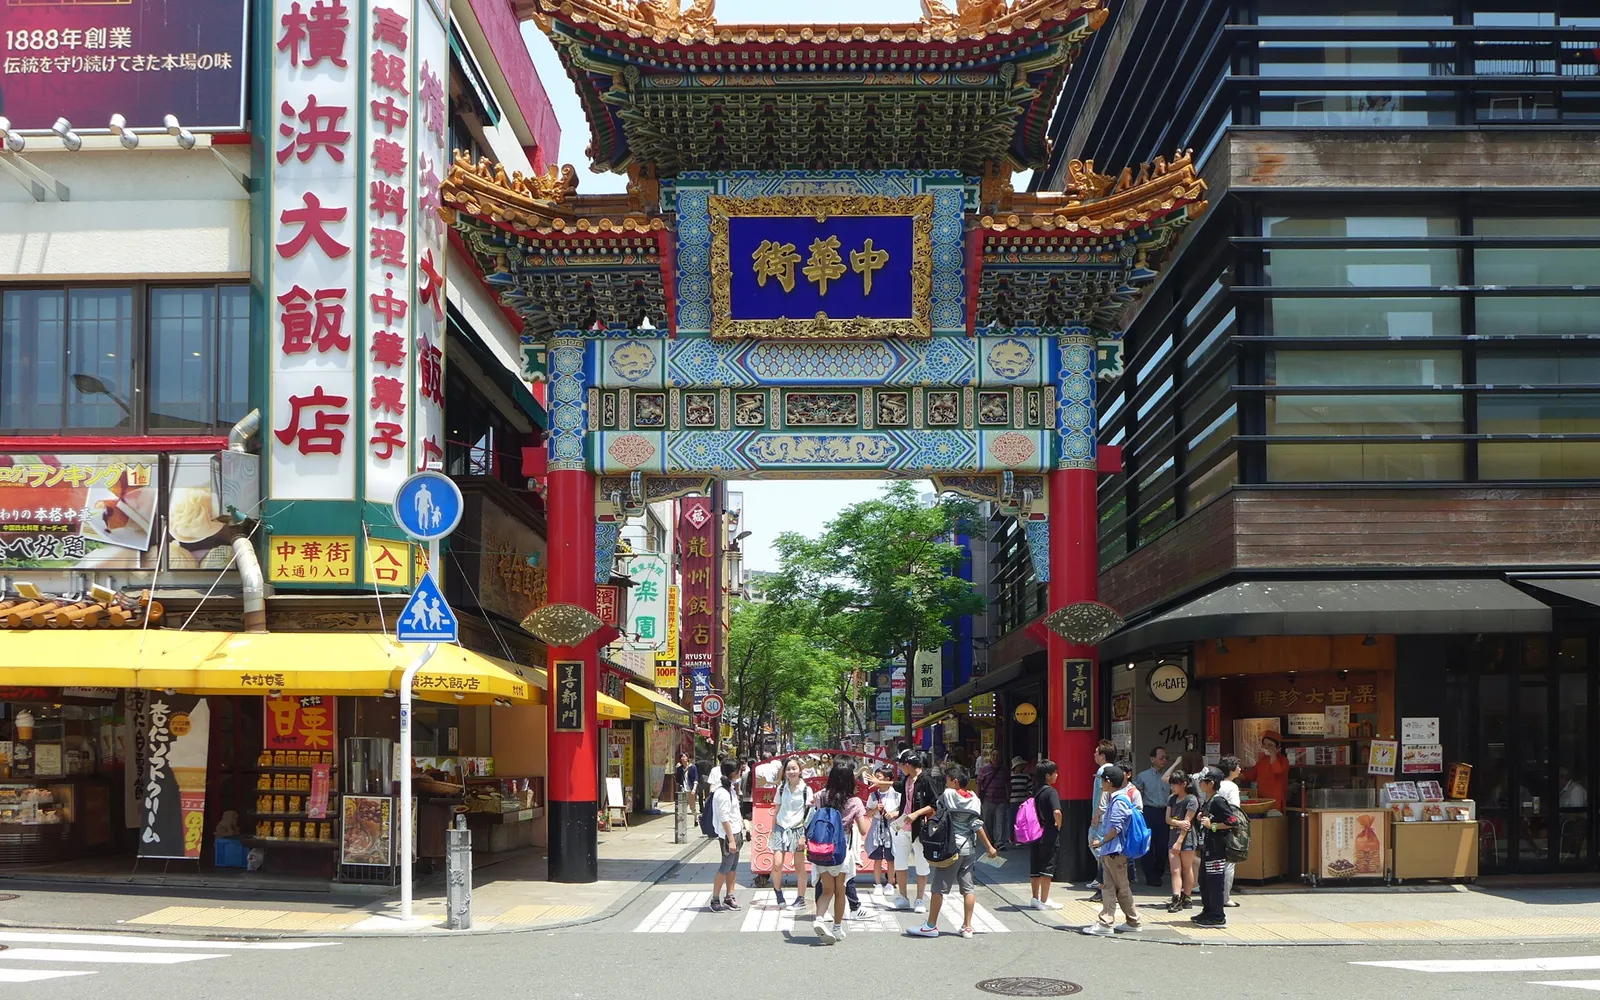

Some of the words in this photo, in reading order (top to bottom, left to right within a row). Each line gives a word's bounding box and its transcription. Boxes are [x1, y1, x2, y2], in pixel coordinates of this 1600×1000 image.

[4, 27, 132, 50] 1888年創業
[3, 53, 233, 75] 伝統を守り続けてきた本場の味
[275, 1, 351, 456] 横浜大飯店
[752, 235, 890, 296] 中華街
[131, 471, 148, 486] 1位
[275, 540, 351, 563] 中華街
[275, 563, 350, 578] 大通り入口
[374, 545, 403, 582] 入口
[685, 536, 713, 646] 龍州飯店
[634, 580, 659, 638] 楽園
[240, 673, 285, 687] 大粒甘栗
[656, 667, 676, 677] 100円
[920, 663, 933, 688] 新館
[1165, 676, 1186, 689] CAFE
[300, 695, 322, 708] 大粒
[706, 700, 719, 711] 30
[1254, 684, 1378, 708] 聘珍大甘栗
[1158, 724, 1189, 744] The
[142, 700, 170, 843] 杏仁ソフトクリーム
